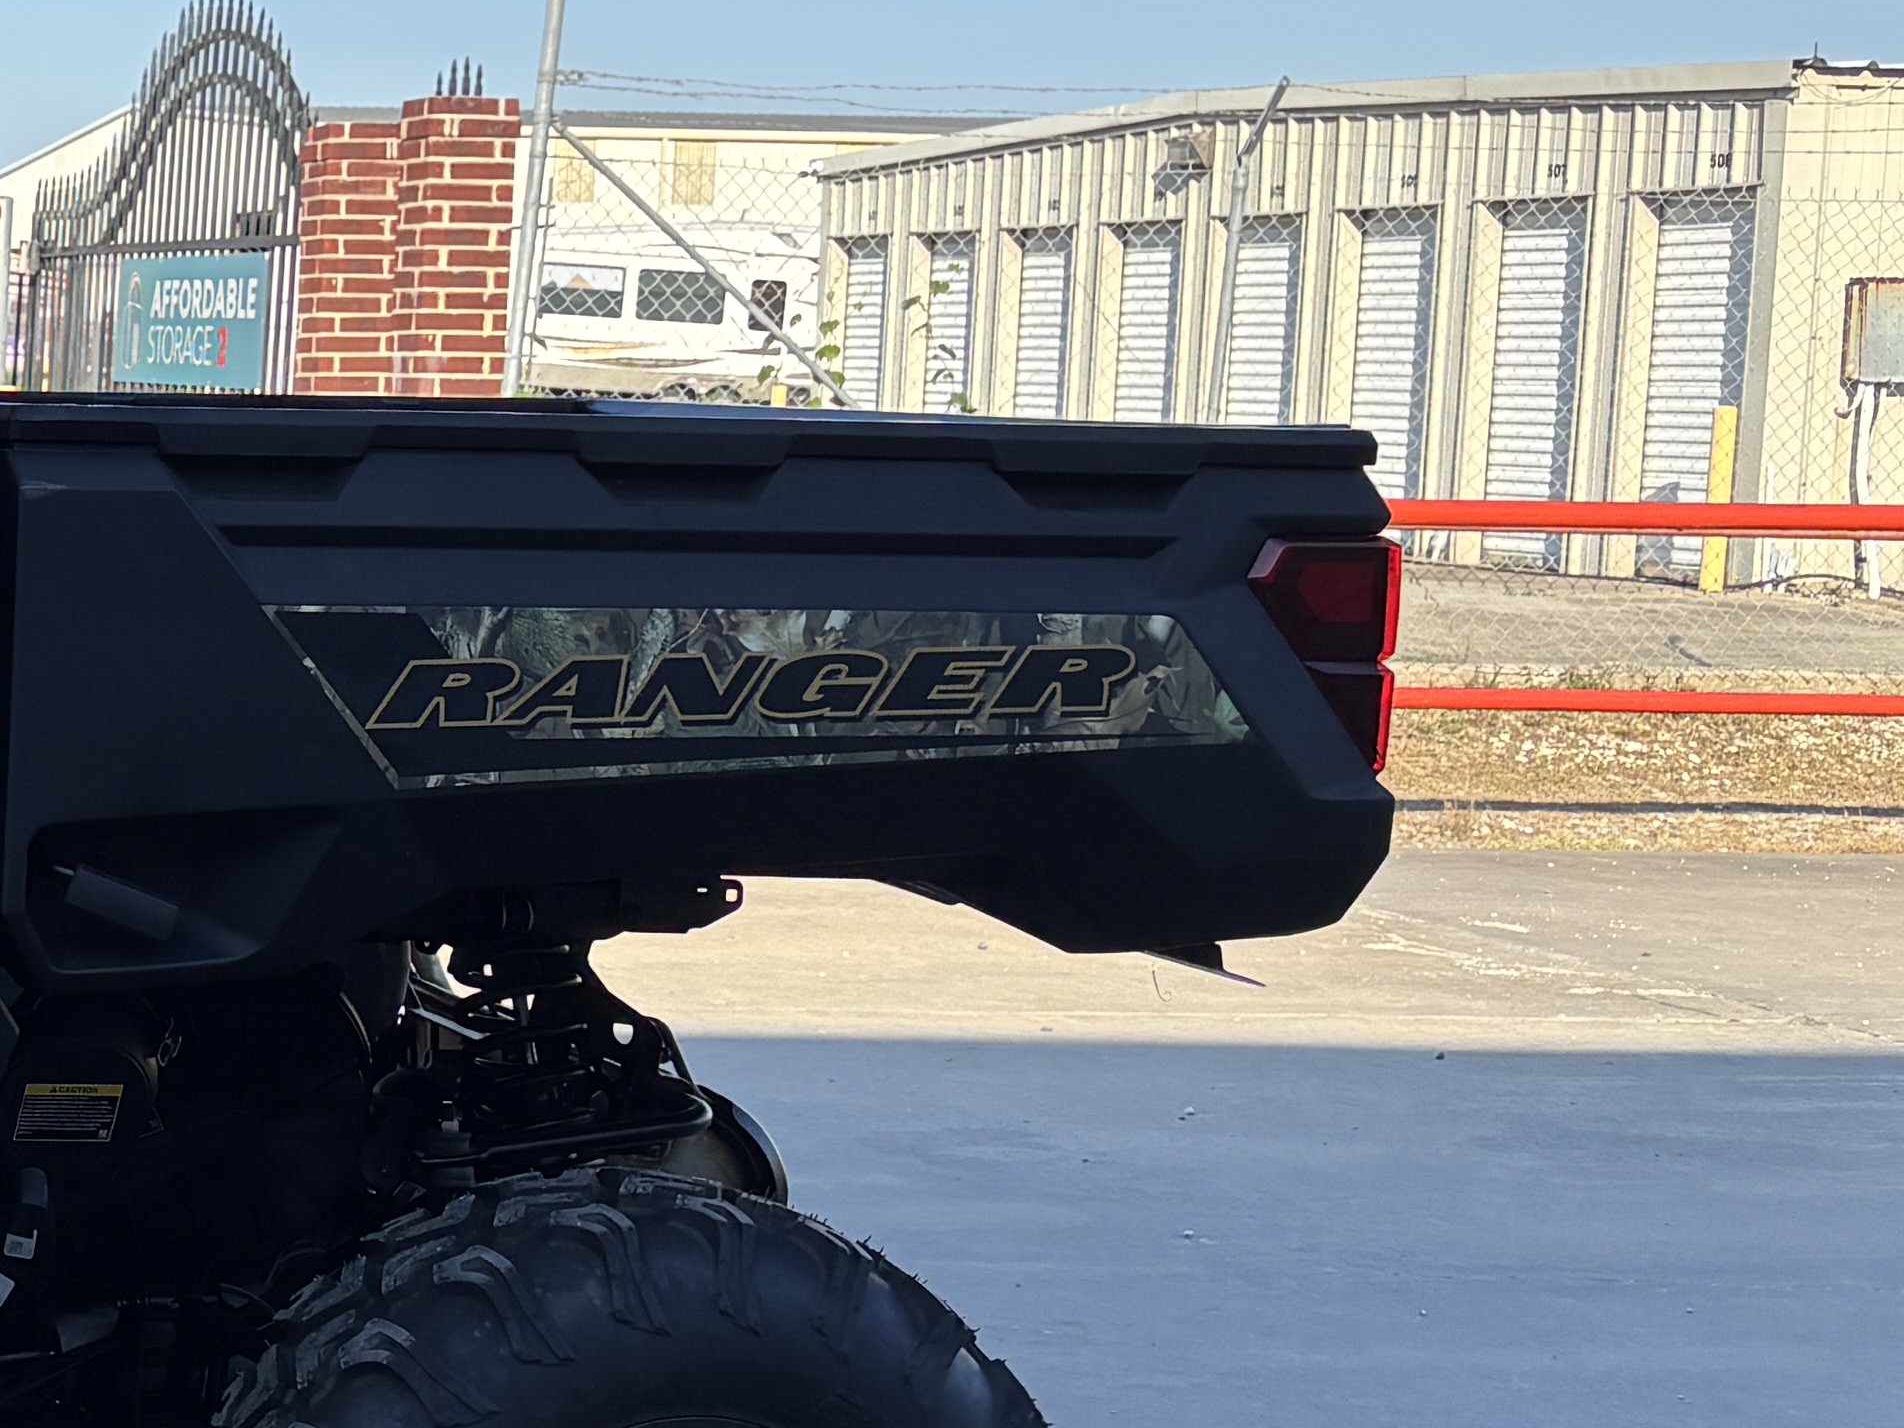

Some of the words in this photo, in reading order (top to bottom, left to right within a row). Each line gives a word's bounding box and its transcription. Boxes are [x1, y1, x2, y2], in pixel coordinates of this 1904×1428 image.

[149, 278, 258, 319] AFFORDABLE
[147, 325, 214, 366] STORAGE
[365, 643, 1137, 730] RANGER
